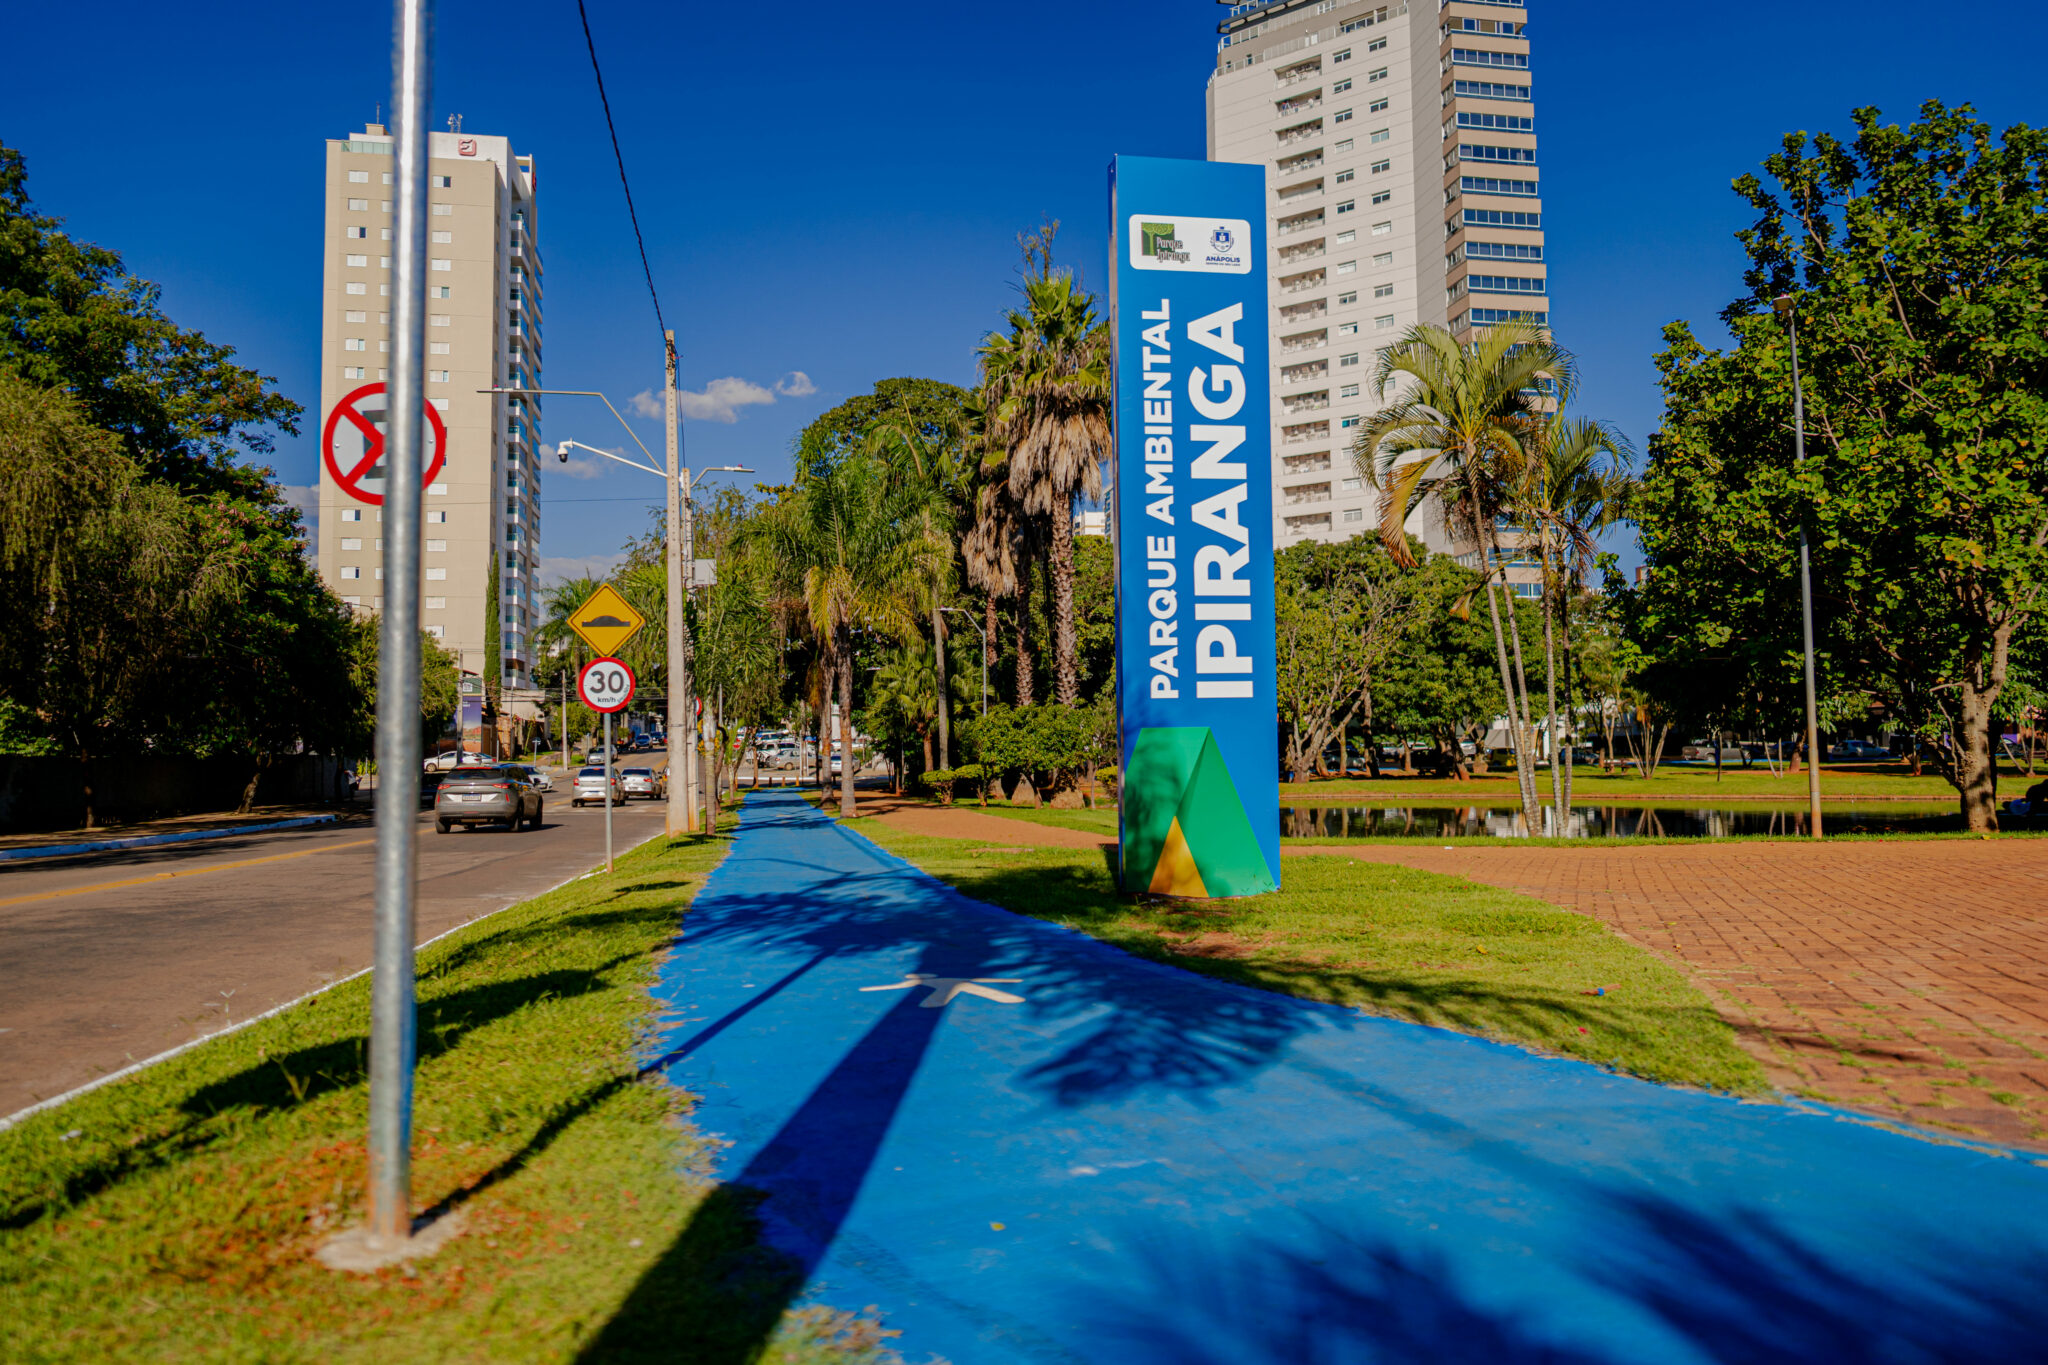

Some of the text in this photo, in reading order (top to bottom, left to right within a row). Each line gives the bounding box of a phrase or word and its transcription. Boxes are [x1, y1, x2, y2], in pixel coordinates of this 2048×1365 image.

[589, 670, 625, 694] 30
[1141, 298, 1180, 699] PARQUE AMBIENTAL
[1187, 302, 1254, 699] IPIRANGA
